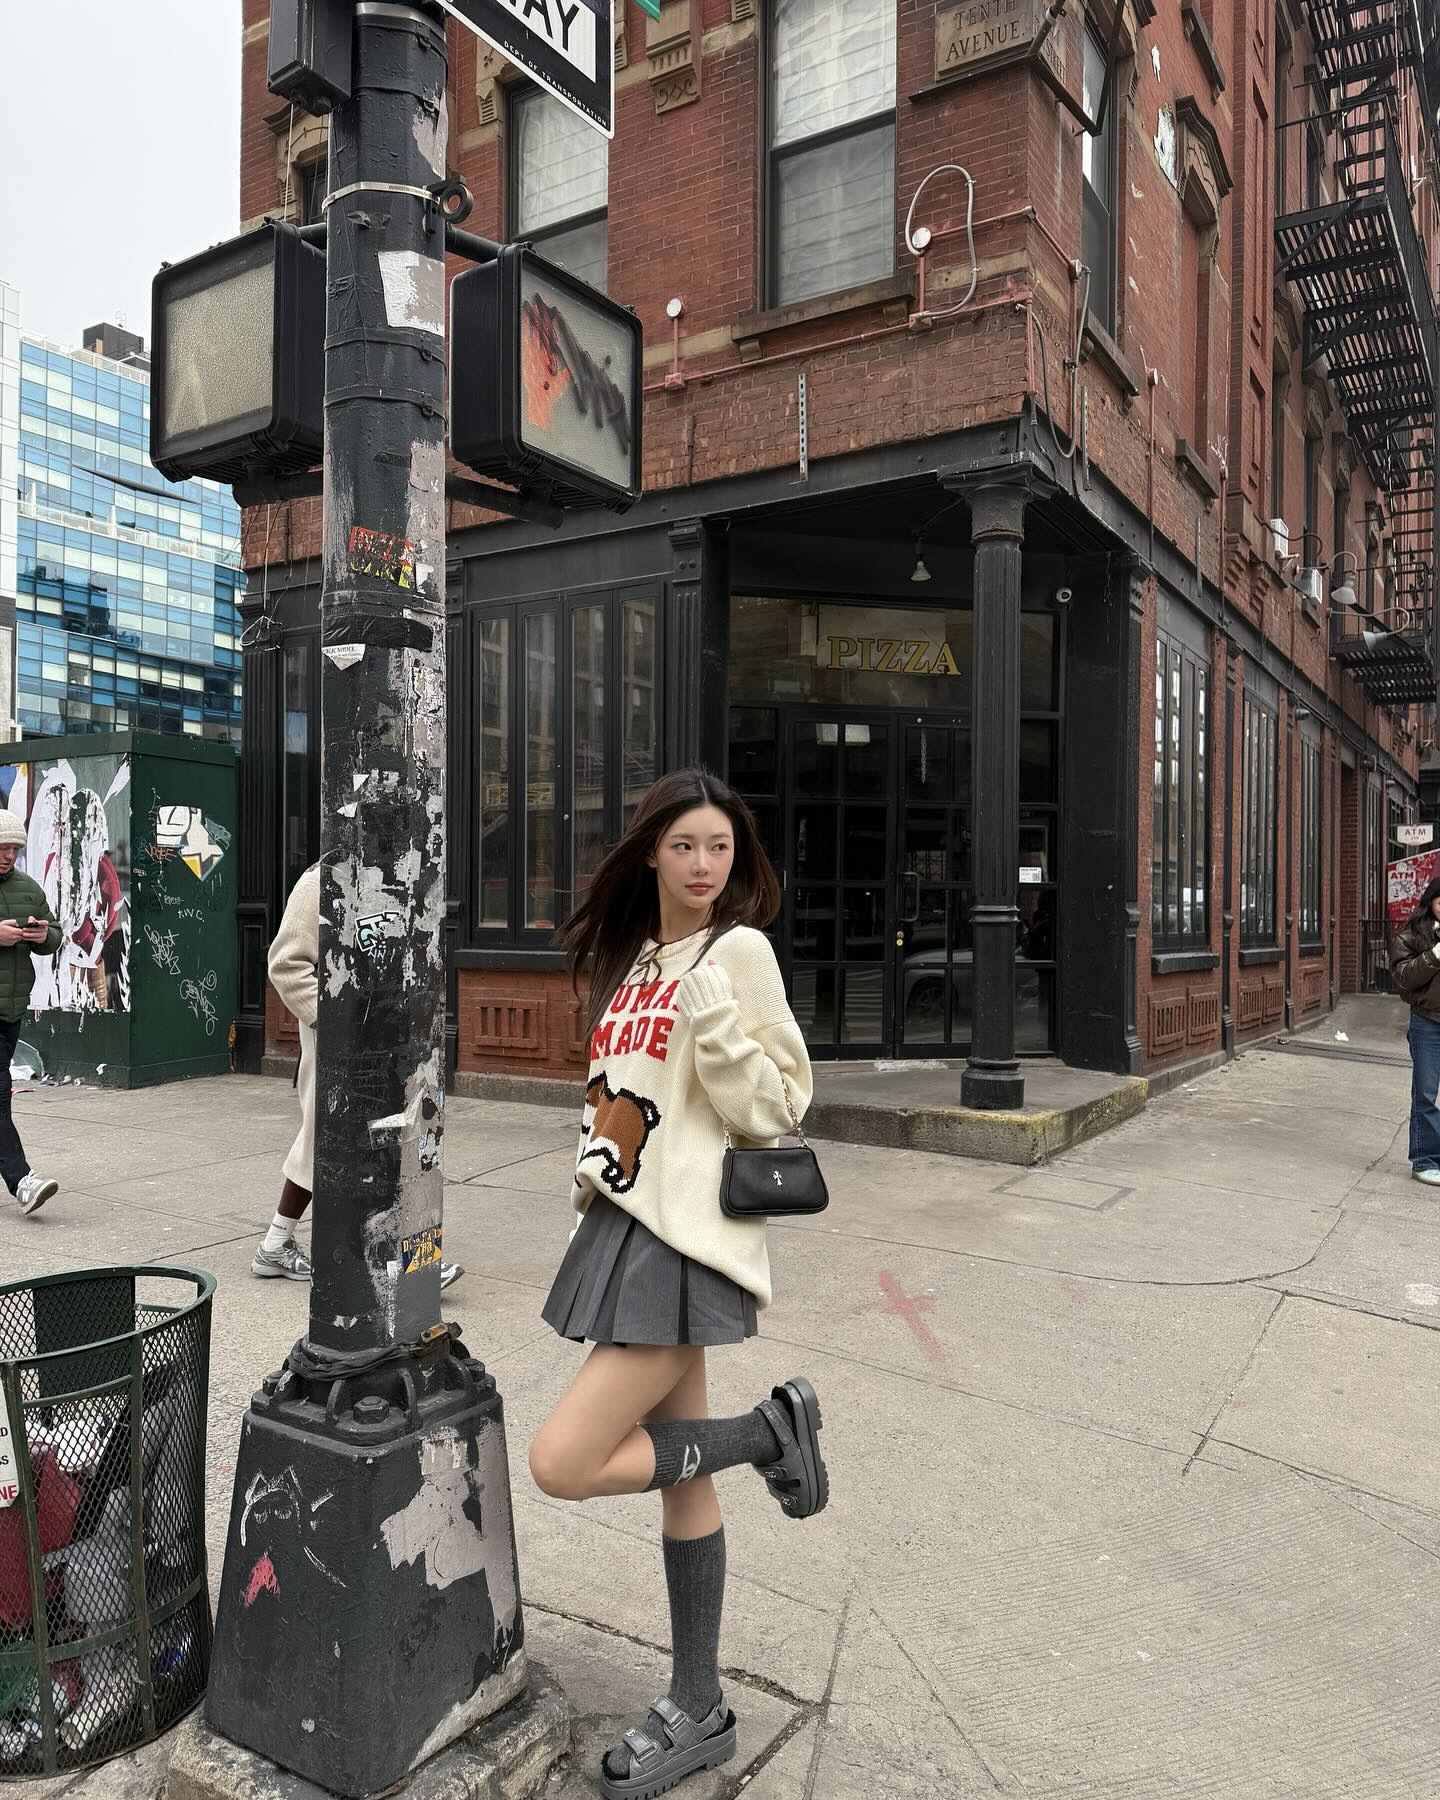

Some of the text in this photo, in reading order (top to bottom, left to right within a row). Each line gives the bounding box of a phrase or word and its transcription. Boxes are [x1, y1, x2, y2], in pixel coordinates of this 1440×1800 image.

[509, 0, 579, 51] AY
[953, 0, 1016, 30] TENTH
[946, 20, 1025, 62] AVENUE.
[504, 41, 607, 126] DEPT OF TRANSPORTATION
[826, 636, 961, 676] PIZZA
[1405, 828, 1426, 836] ATM
[1391, 871, 1414, 880] ATM
[610, 980, 680, 1013] UMA
[591, 1016, 675, 1062] MADE
